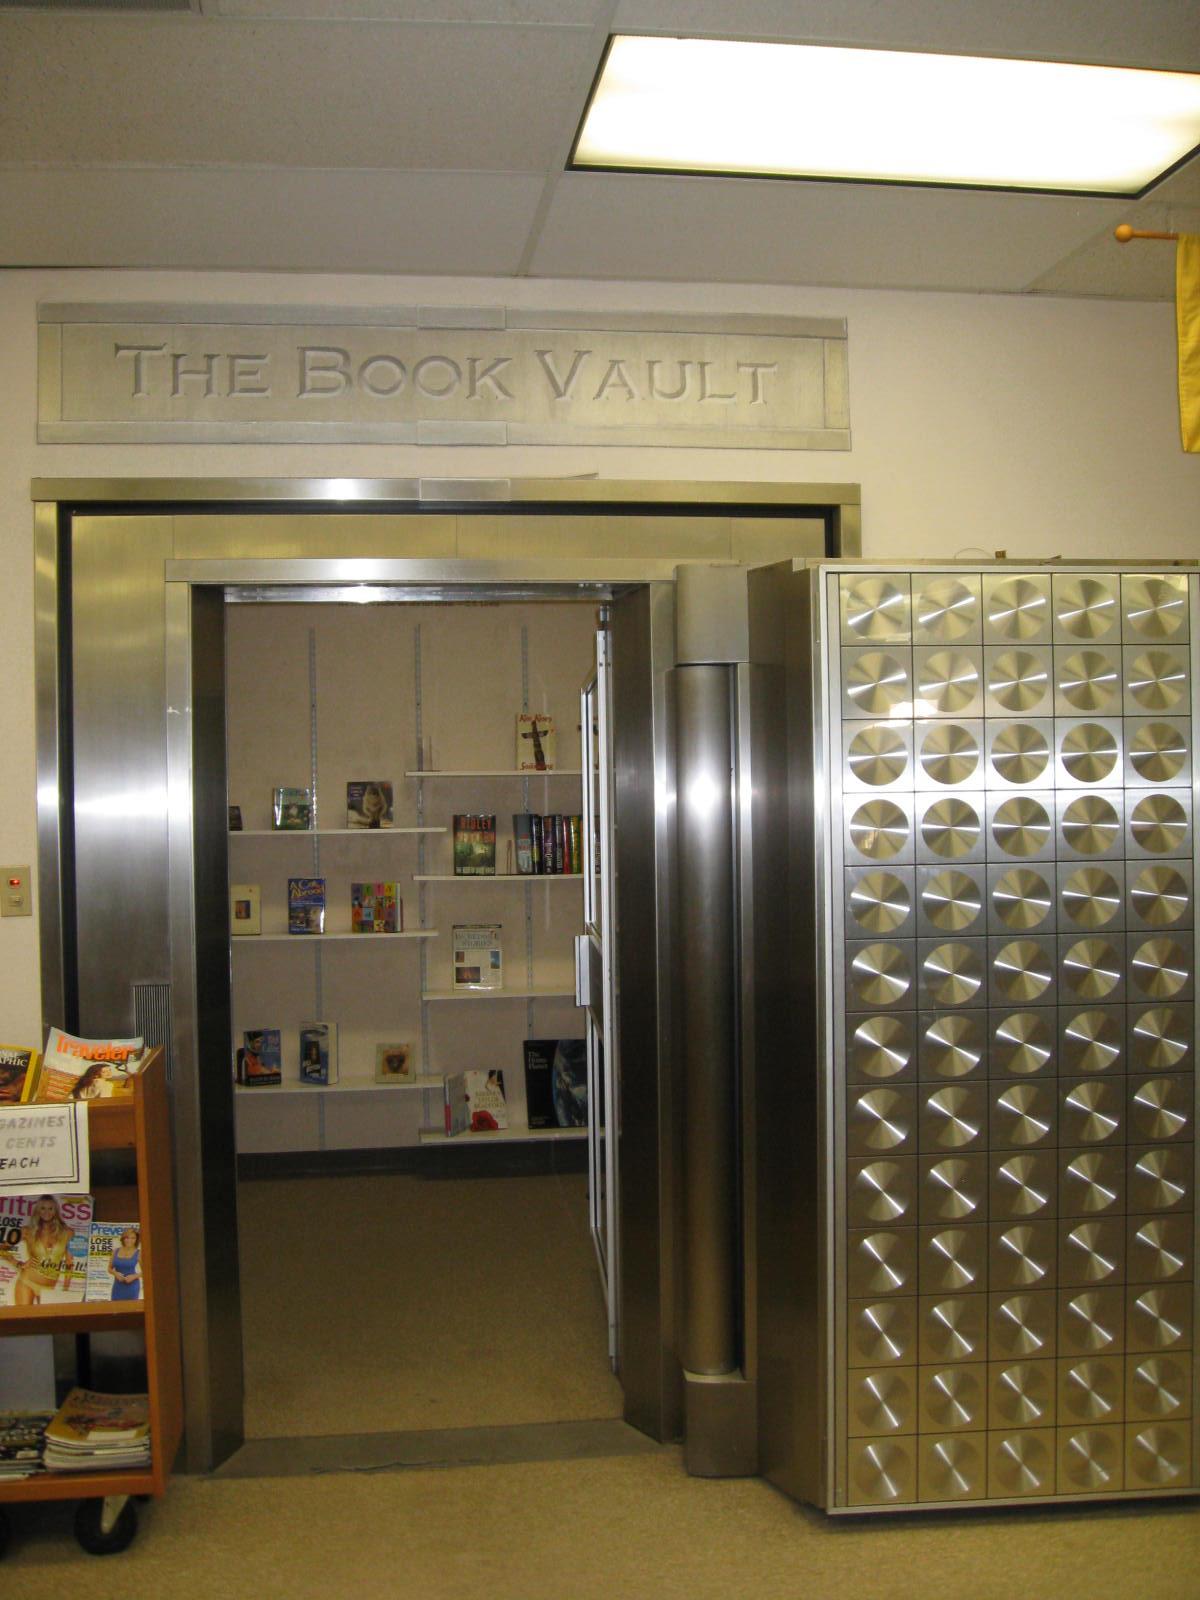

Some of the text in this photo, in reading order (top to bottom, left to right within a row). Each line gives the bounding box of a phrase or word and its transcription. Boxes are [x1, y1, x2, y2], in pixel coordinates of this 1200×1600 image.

[56, 1034, 136, 1062] Traveler
[6, 1136, 57, 1150] CENTS
[90, 1237, 112, 1245] LOSE
